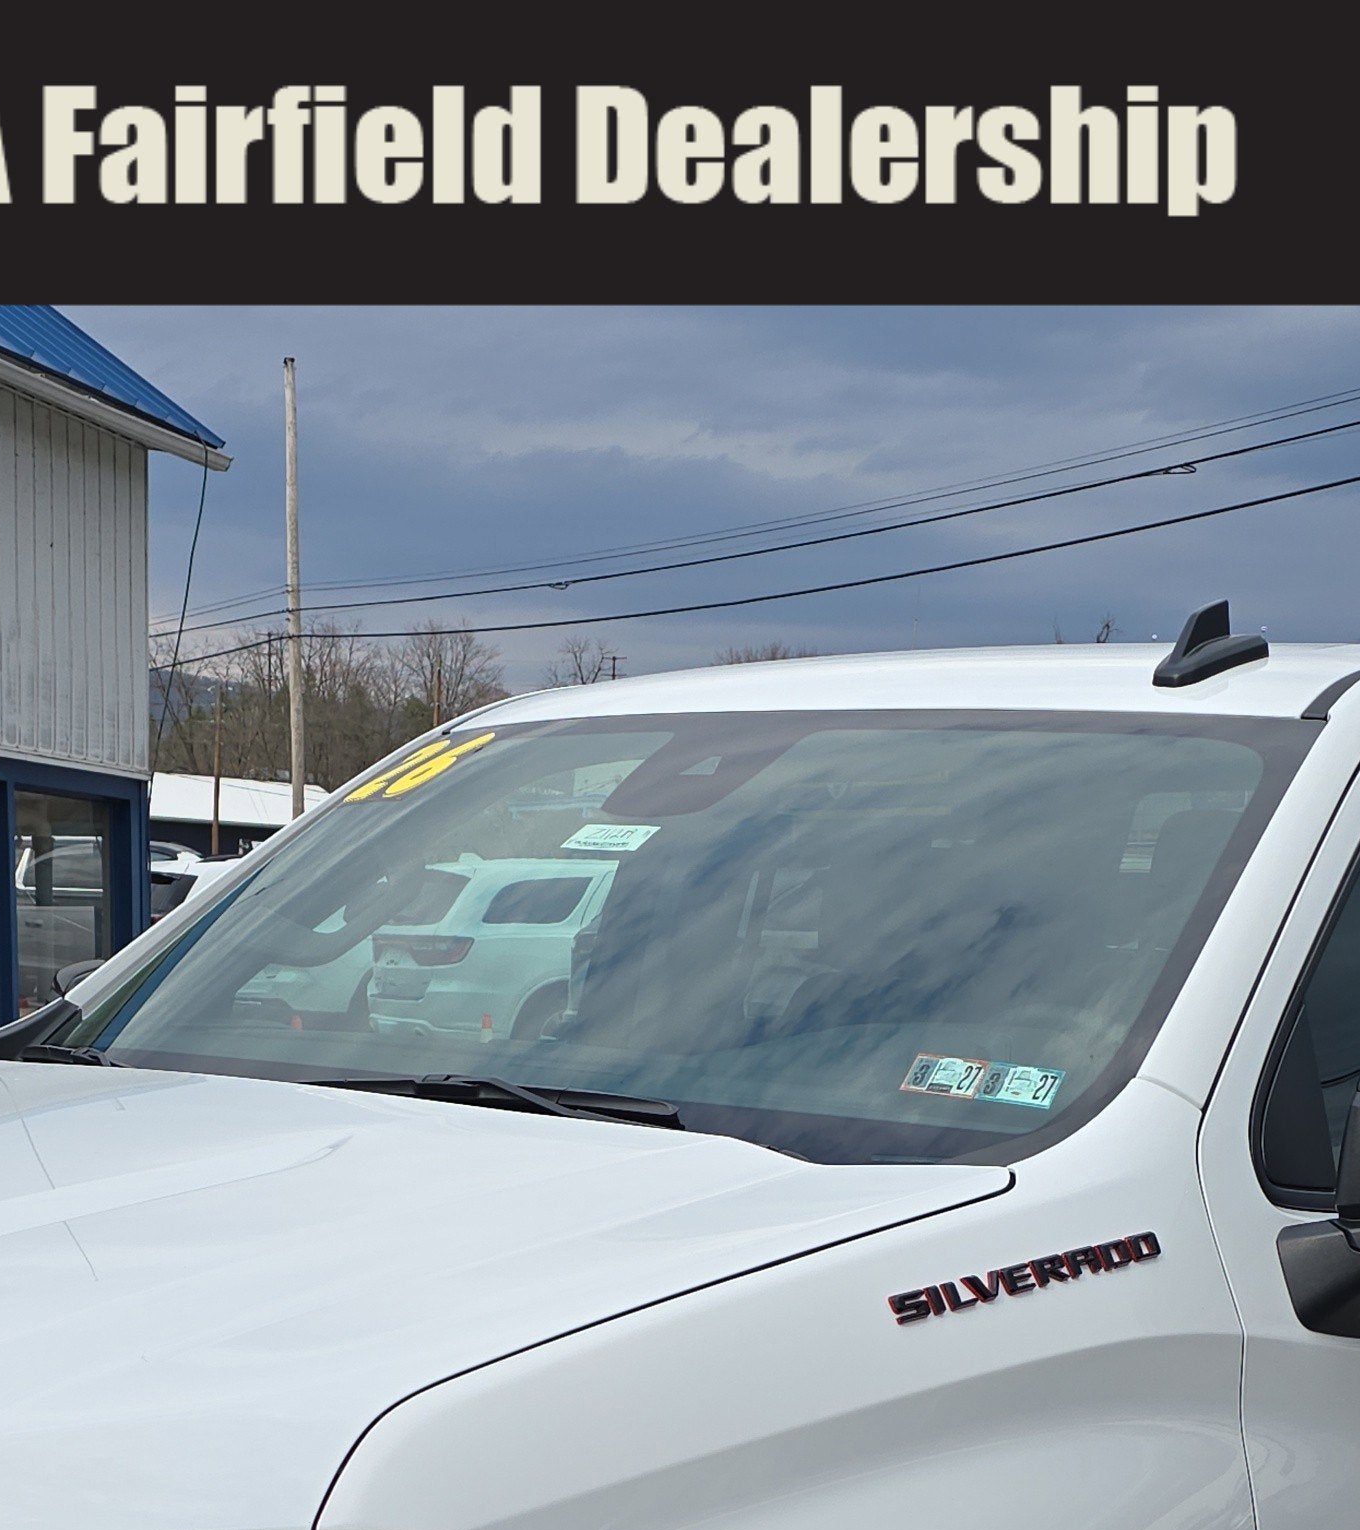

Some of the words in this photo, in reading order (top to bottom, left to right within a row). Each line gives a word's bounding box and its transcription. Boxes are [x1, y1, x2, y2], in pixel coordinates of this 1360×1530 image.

[913, 1064, 930, 1086] 3
[956, 1065, 983, 1092] 27
[983, 1072, 1001, 1095] 3
[1032, 1074, 1058, 1102] 27
[888, 1230, 1161, 1325] SILVERADO
